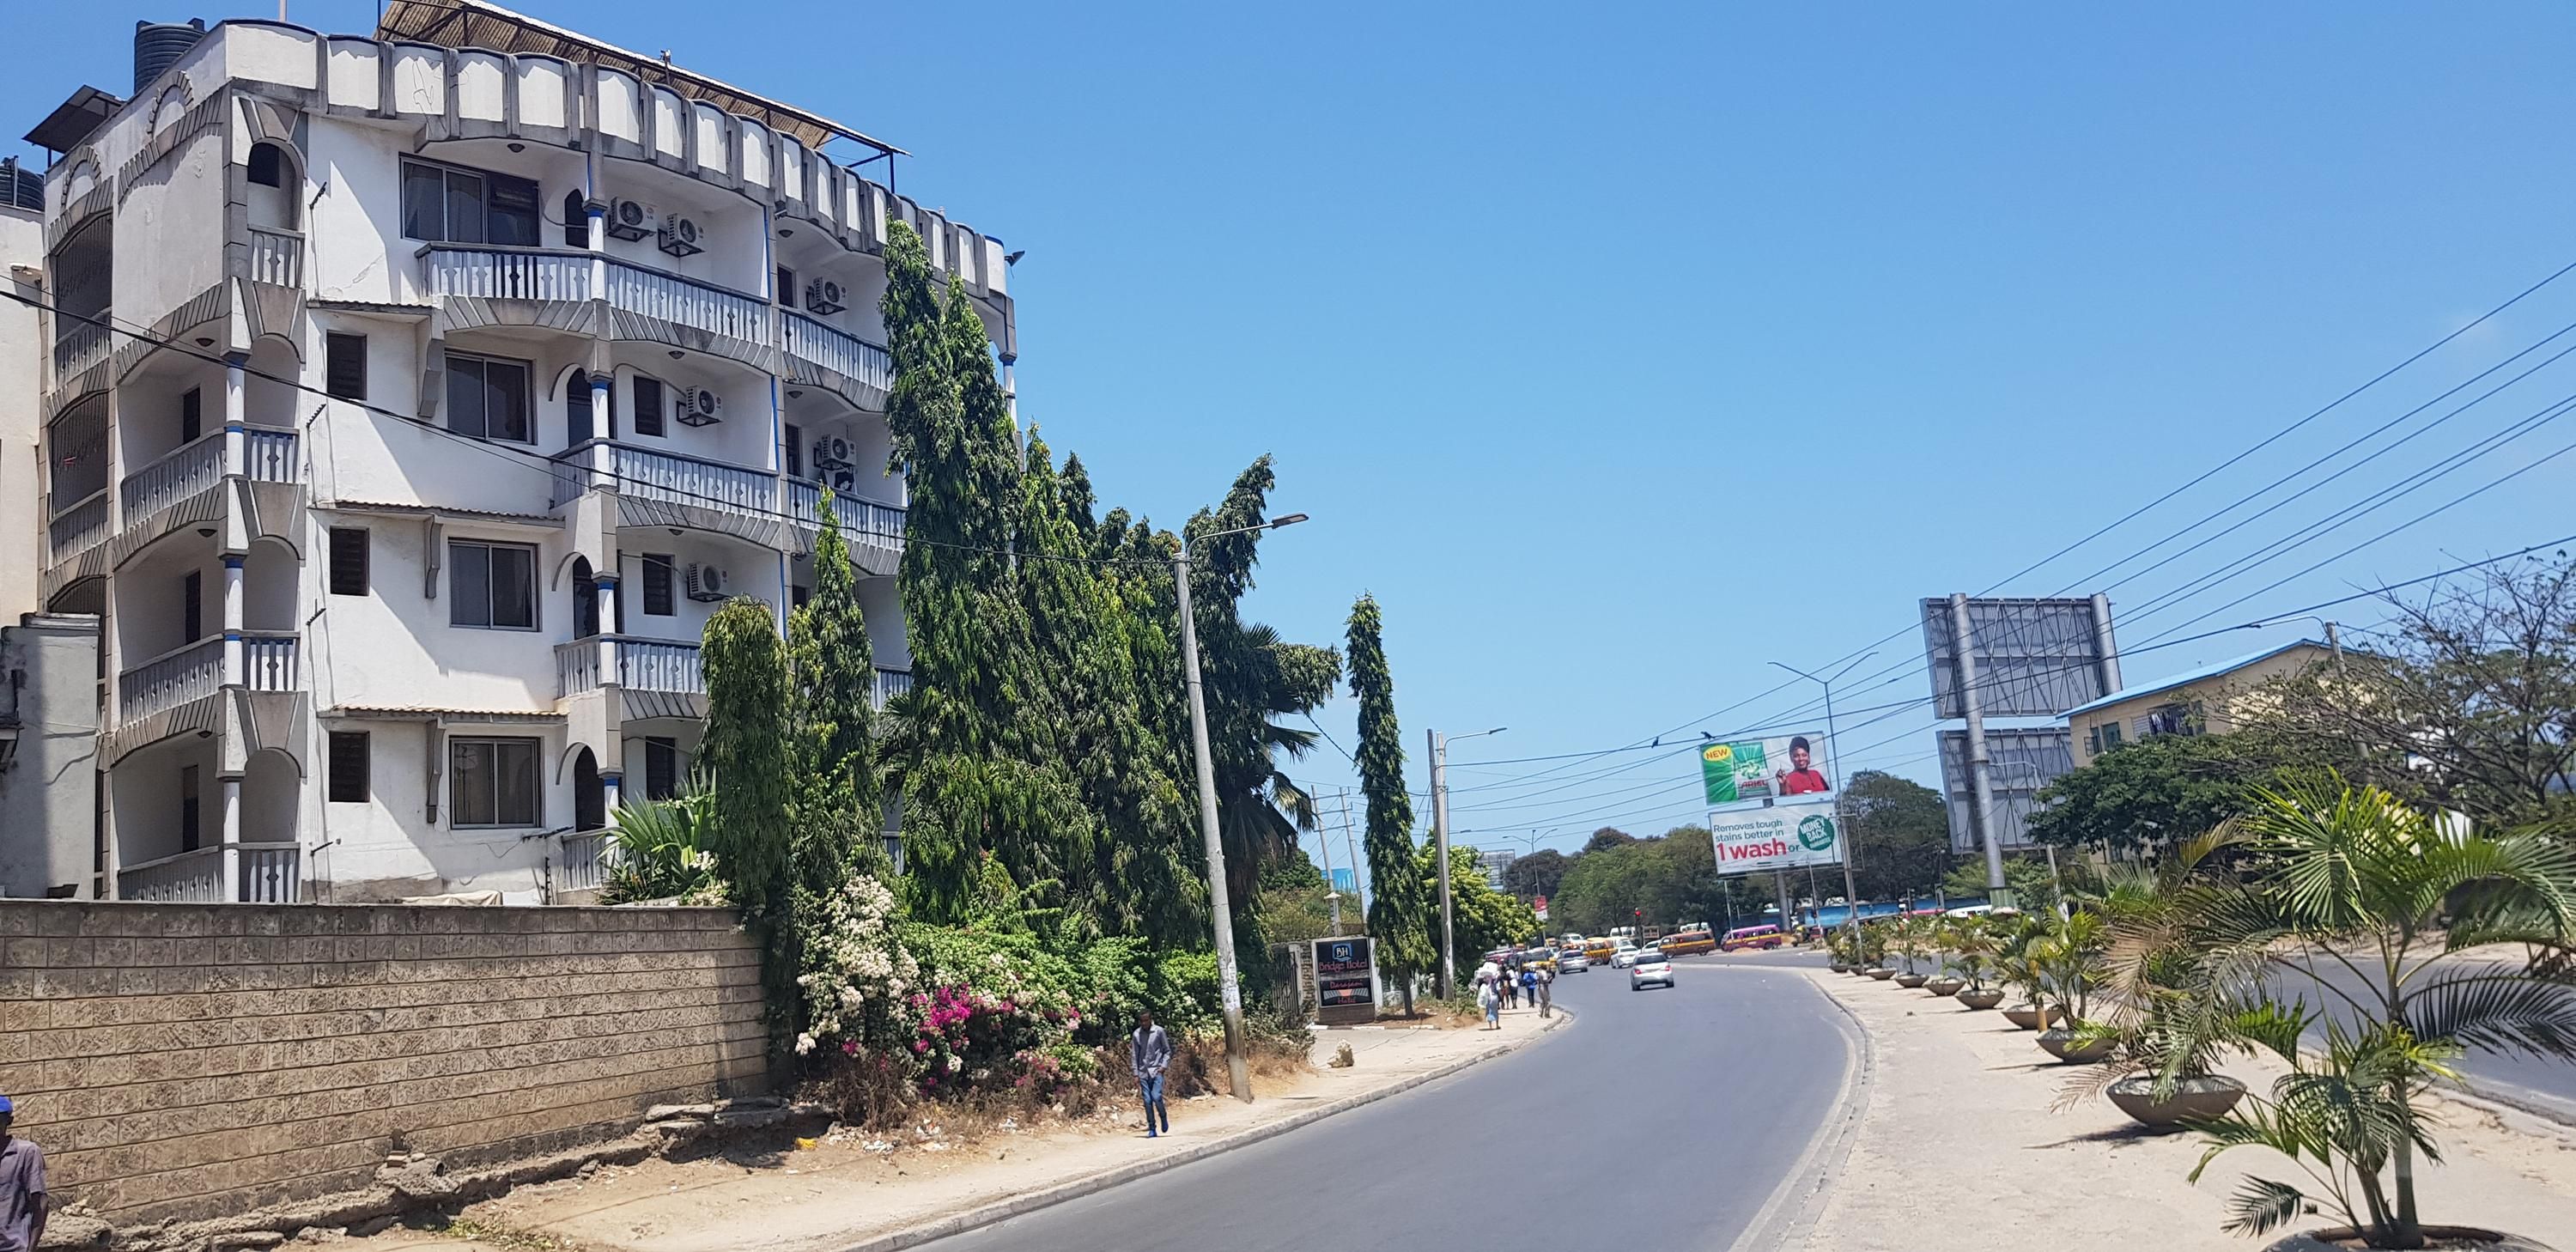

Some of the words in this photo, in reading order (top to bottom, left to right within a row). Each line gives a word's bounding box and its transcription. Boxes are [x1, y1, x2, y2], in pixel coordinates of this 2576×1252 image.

[1705, 748, 1728, 760] NEW
[1714, 822, 1754, 833] Removes
[1756, 818, 1783, 830] tough
[1800, 817, 1825, 834] MONEY
[1716, 832, 1742, 842] stains
[1744, 829, 1772, 840] better
[1775, 829, 1784, 837] in
[1807, 828, 1827, 842] BACK
[1716, 842, 1726, 861] 1
[1728, 837, 1787, 860] wash
[1788, 844, 1800, 853] or
[1319, 961, 1345, 972] Bridge
[1346, 957, 1368, 969] Hotel
